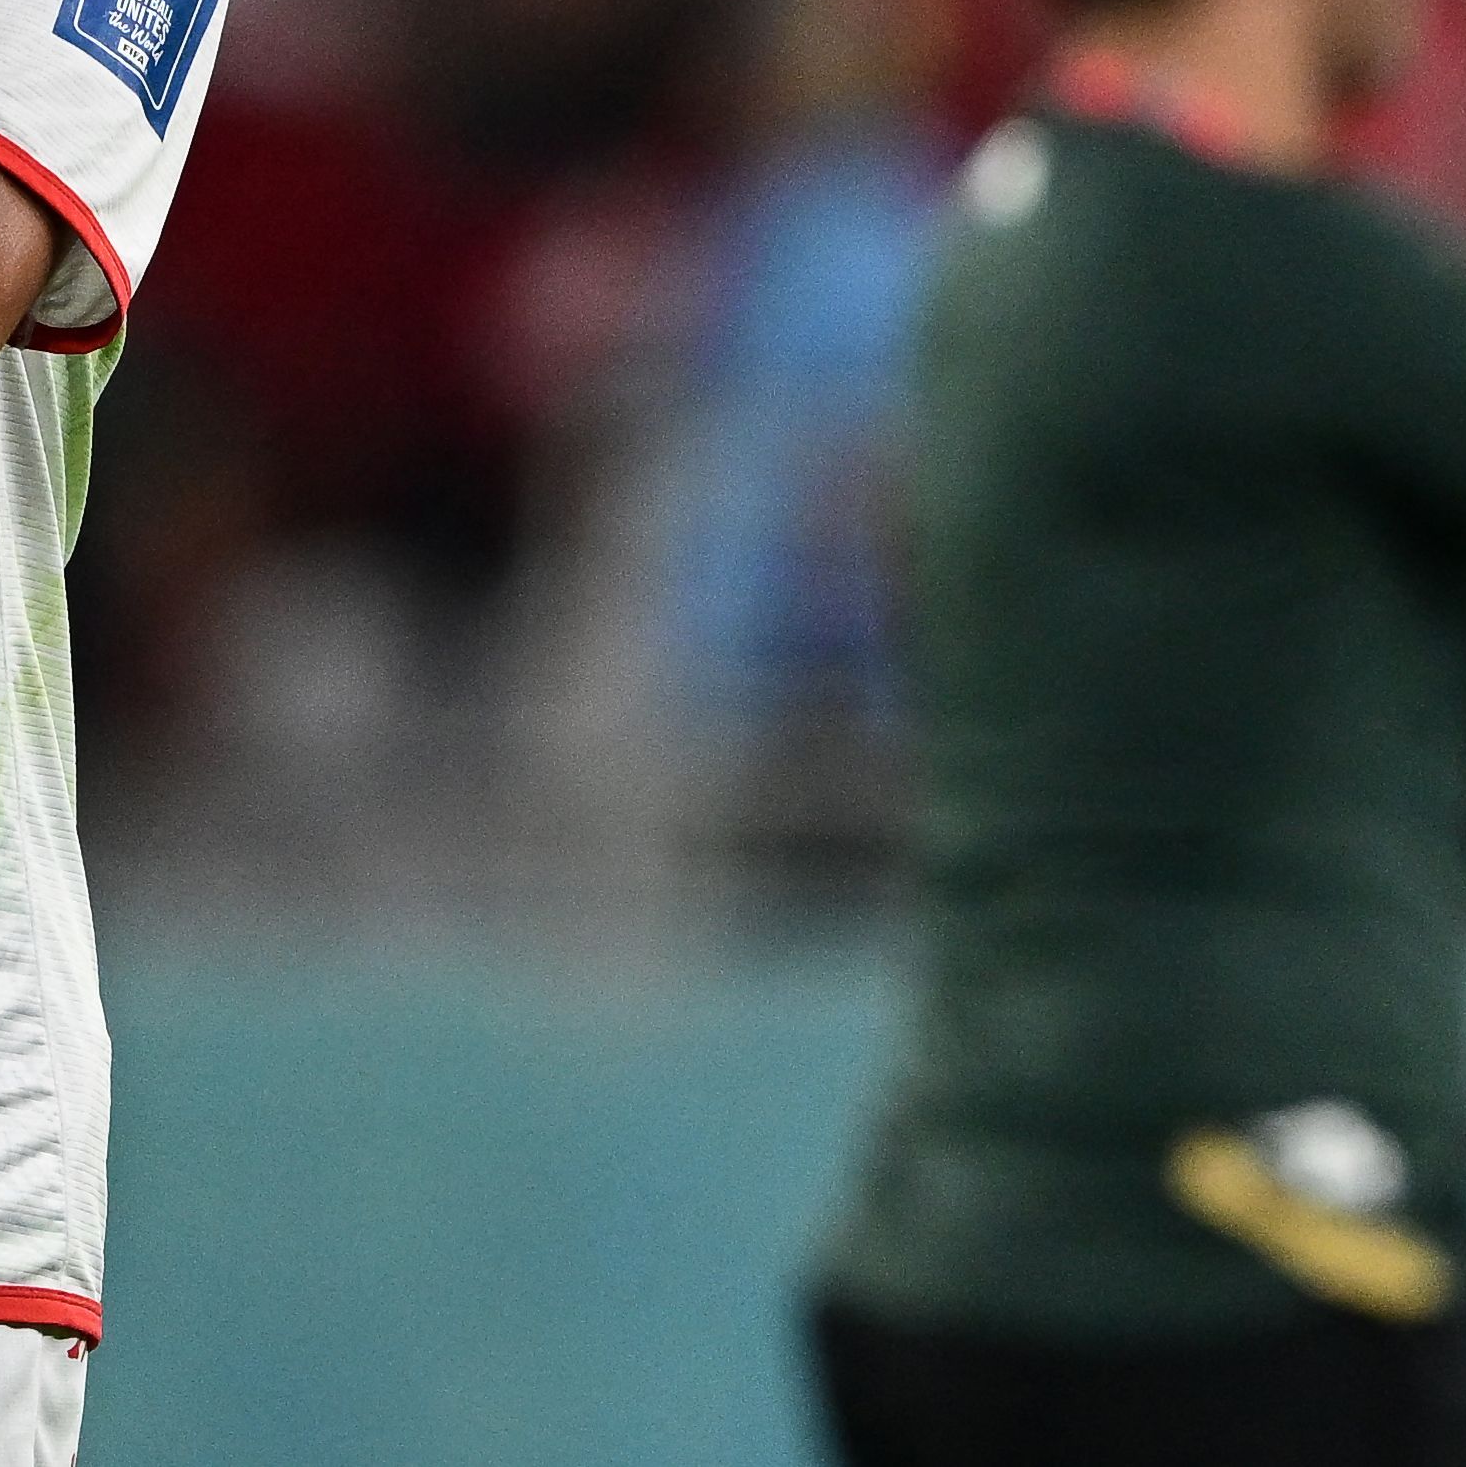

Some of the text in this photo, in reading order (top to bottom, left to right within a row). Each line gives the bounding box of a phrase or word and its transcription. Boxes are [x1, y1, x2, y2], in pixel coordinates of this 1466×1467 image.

[108, 10, 164, 67] the World
[122, 44, 145, 65] FIFA
